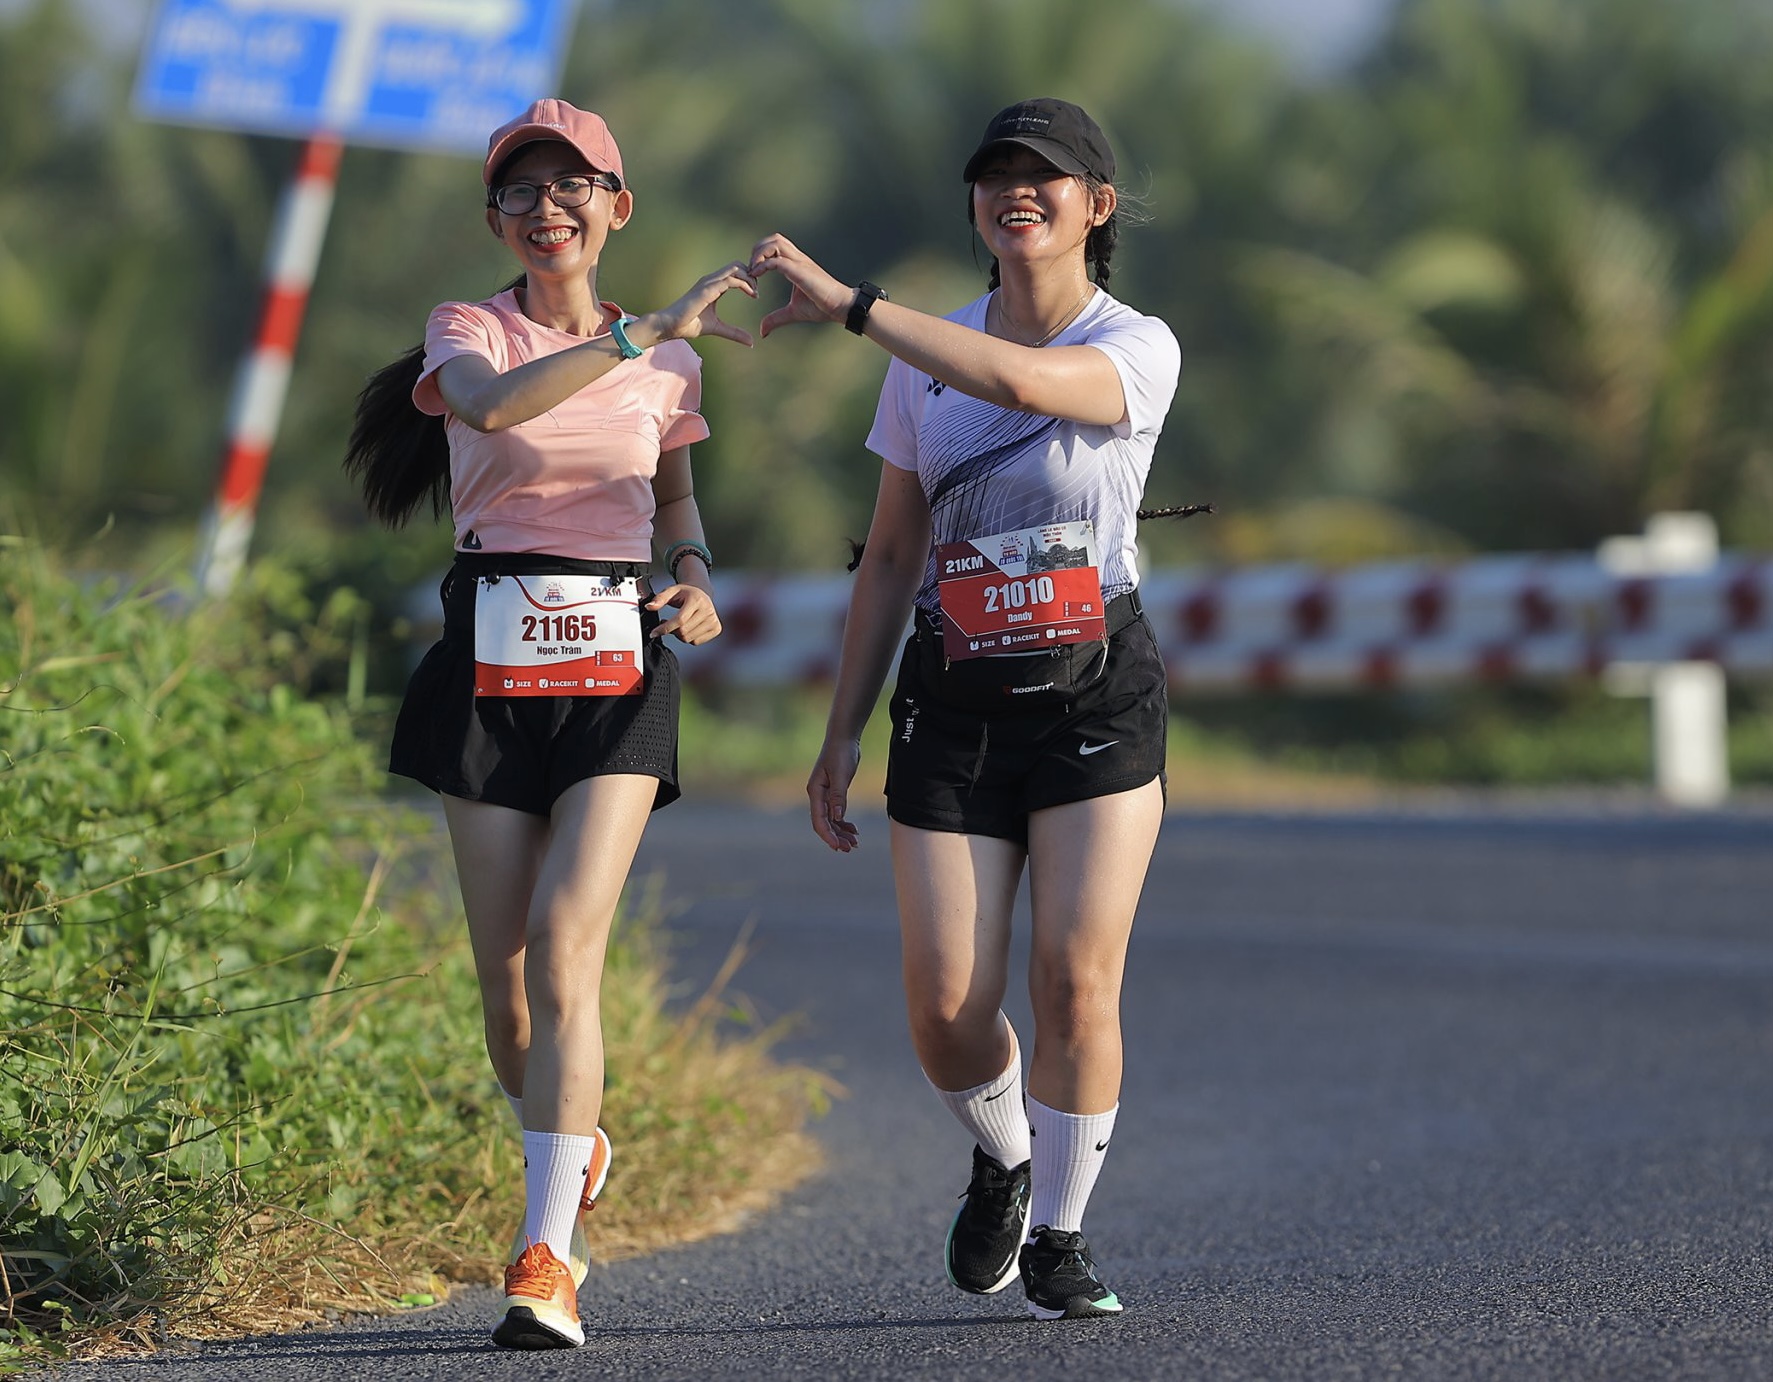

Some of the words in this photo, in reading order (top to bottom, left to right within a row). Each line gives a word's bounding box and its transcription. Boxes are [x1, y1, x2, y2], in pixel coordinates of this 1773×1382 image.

[945, 555, 984, 574] 21KM
[983, 576, 1055, 613] 21010
[1081, 603, 1092, 613] 46
[1007, 611, 1033, 623] Dandy
[521, 615, 597, 642] 21165
[981, 640, 996, 648] SIZE
[1012, 633, 1040, 643] RACEKIT
[1057, 628, 1081, 636] MEDAL
[537, 646, 558, 656] Ngọc
[612, 653, 623, 662] 63
[1012, 683, 1051, 694] GOODFIT
[901, 717, 915, 743] Just
